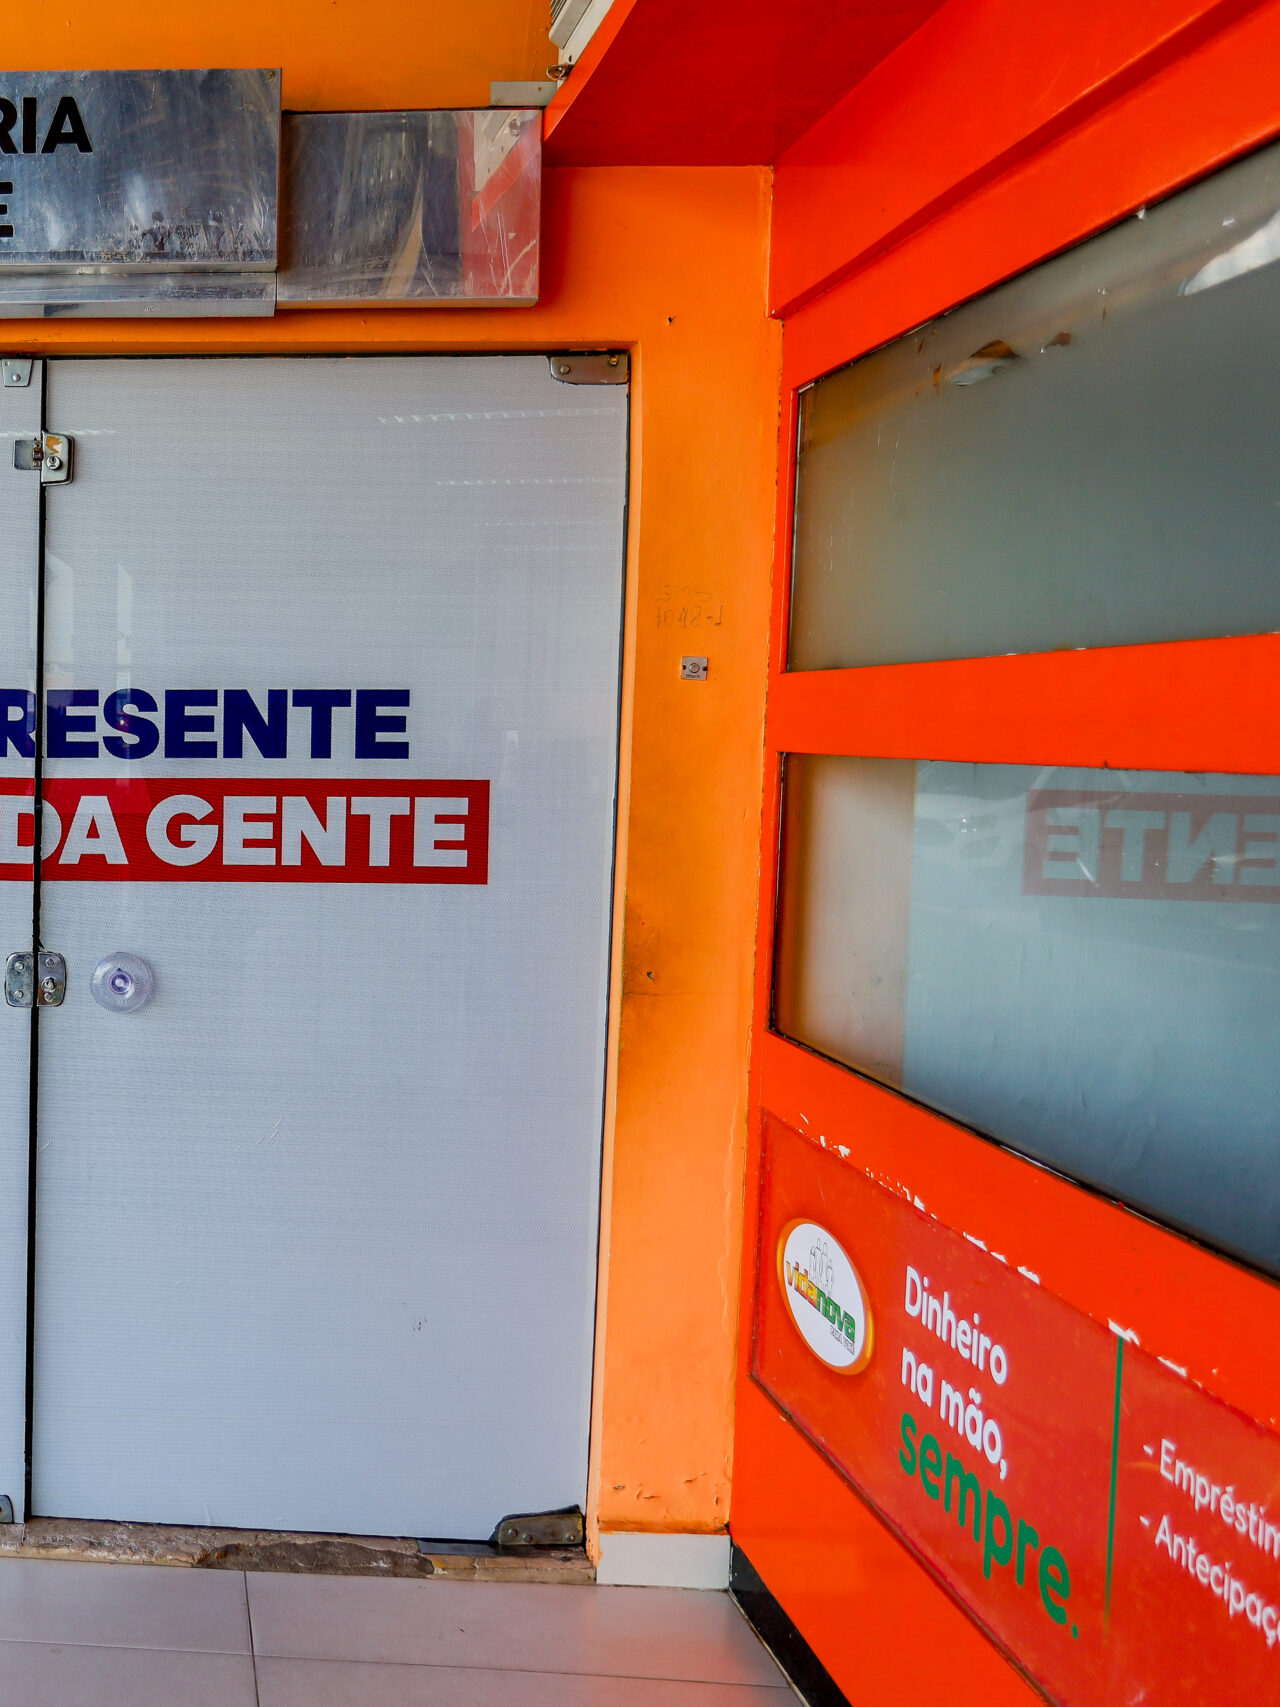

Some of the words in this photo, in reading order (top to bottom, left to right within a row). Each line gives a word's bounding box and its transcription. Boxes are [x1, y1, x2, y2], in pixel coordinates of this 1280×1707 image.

[144, 793, 470, 868] GENTE
[904, 1265, 1008, 1385] Dinheiro
[901, 1346, 934, 1408] na
[939, 1386, 1008, 1481] mão,
[897, 1411, 1079, 1641] sempre.
